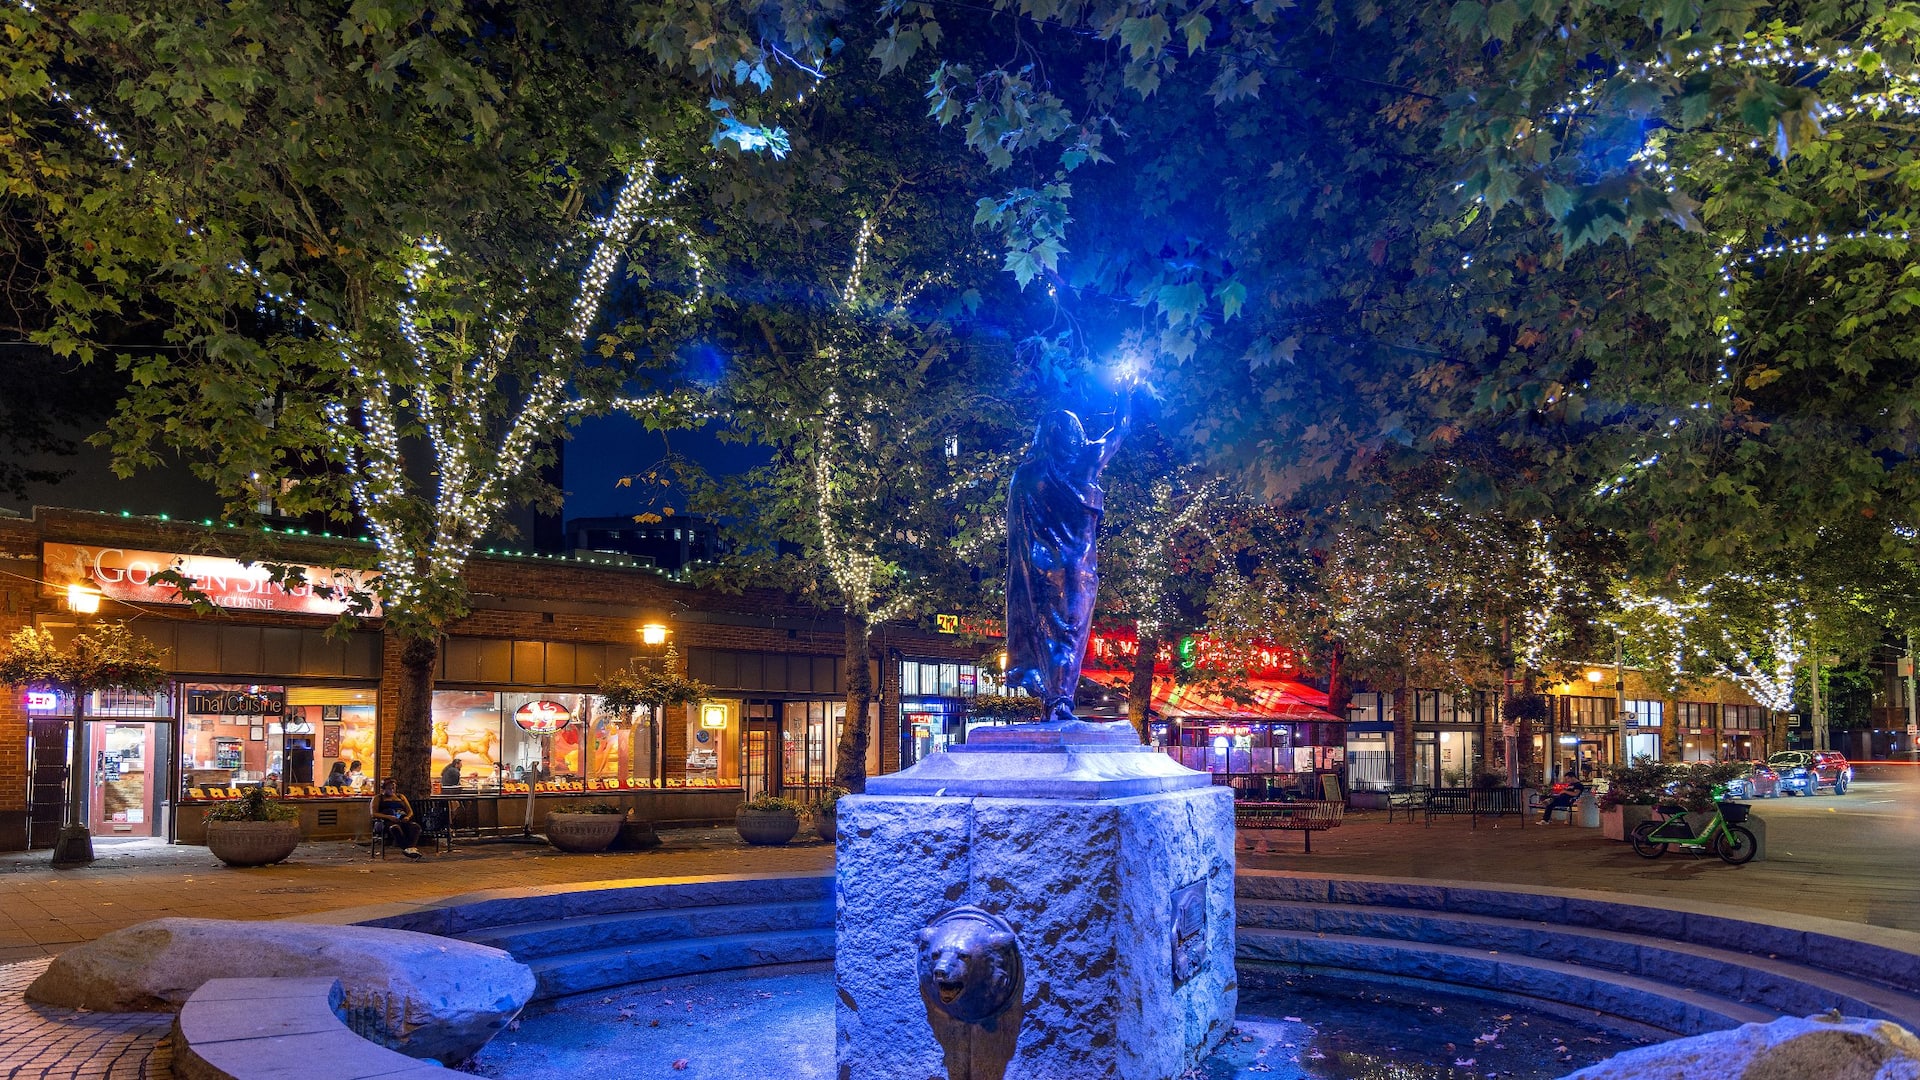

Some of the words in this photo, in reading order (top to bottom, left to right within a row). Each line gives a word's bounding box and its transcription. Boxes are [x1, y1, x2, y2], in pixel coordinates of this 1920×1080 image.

[224, 595, 275, 610] CUISINE
[192, 695, 223, 712] Thai
[227, 695, 281, 712] Cuisine
